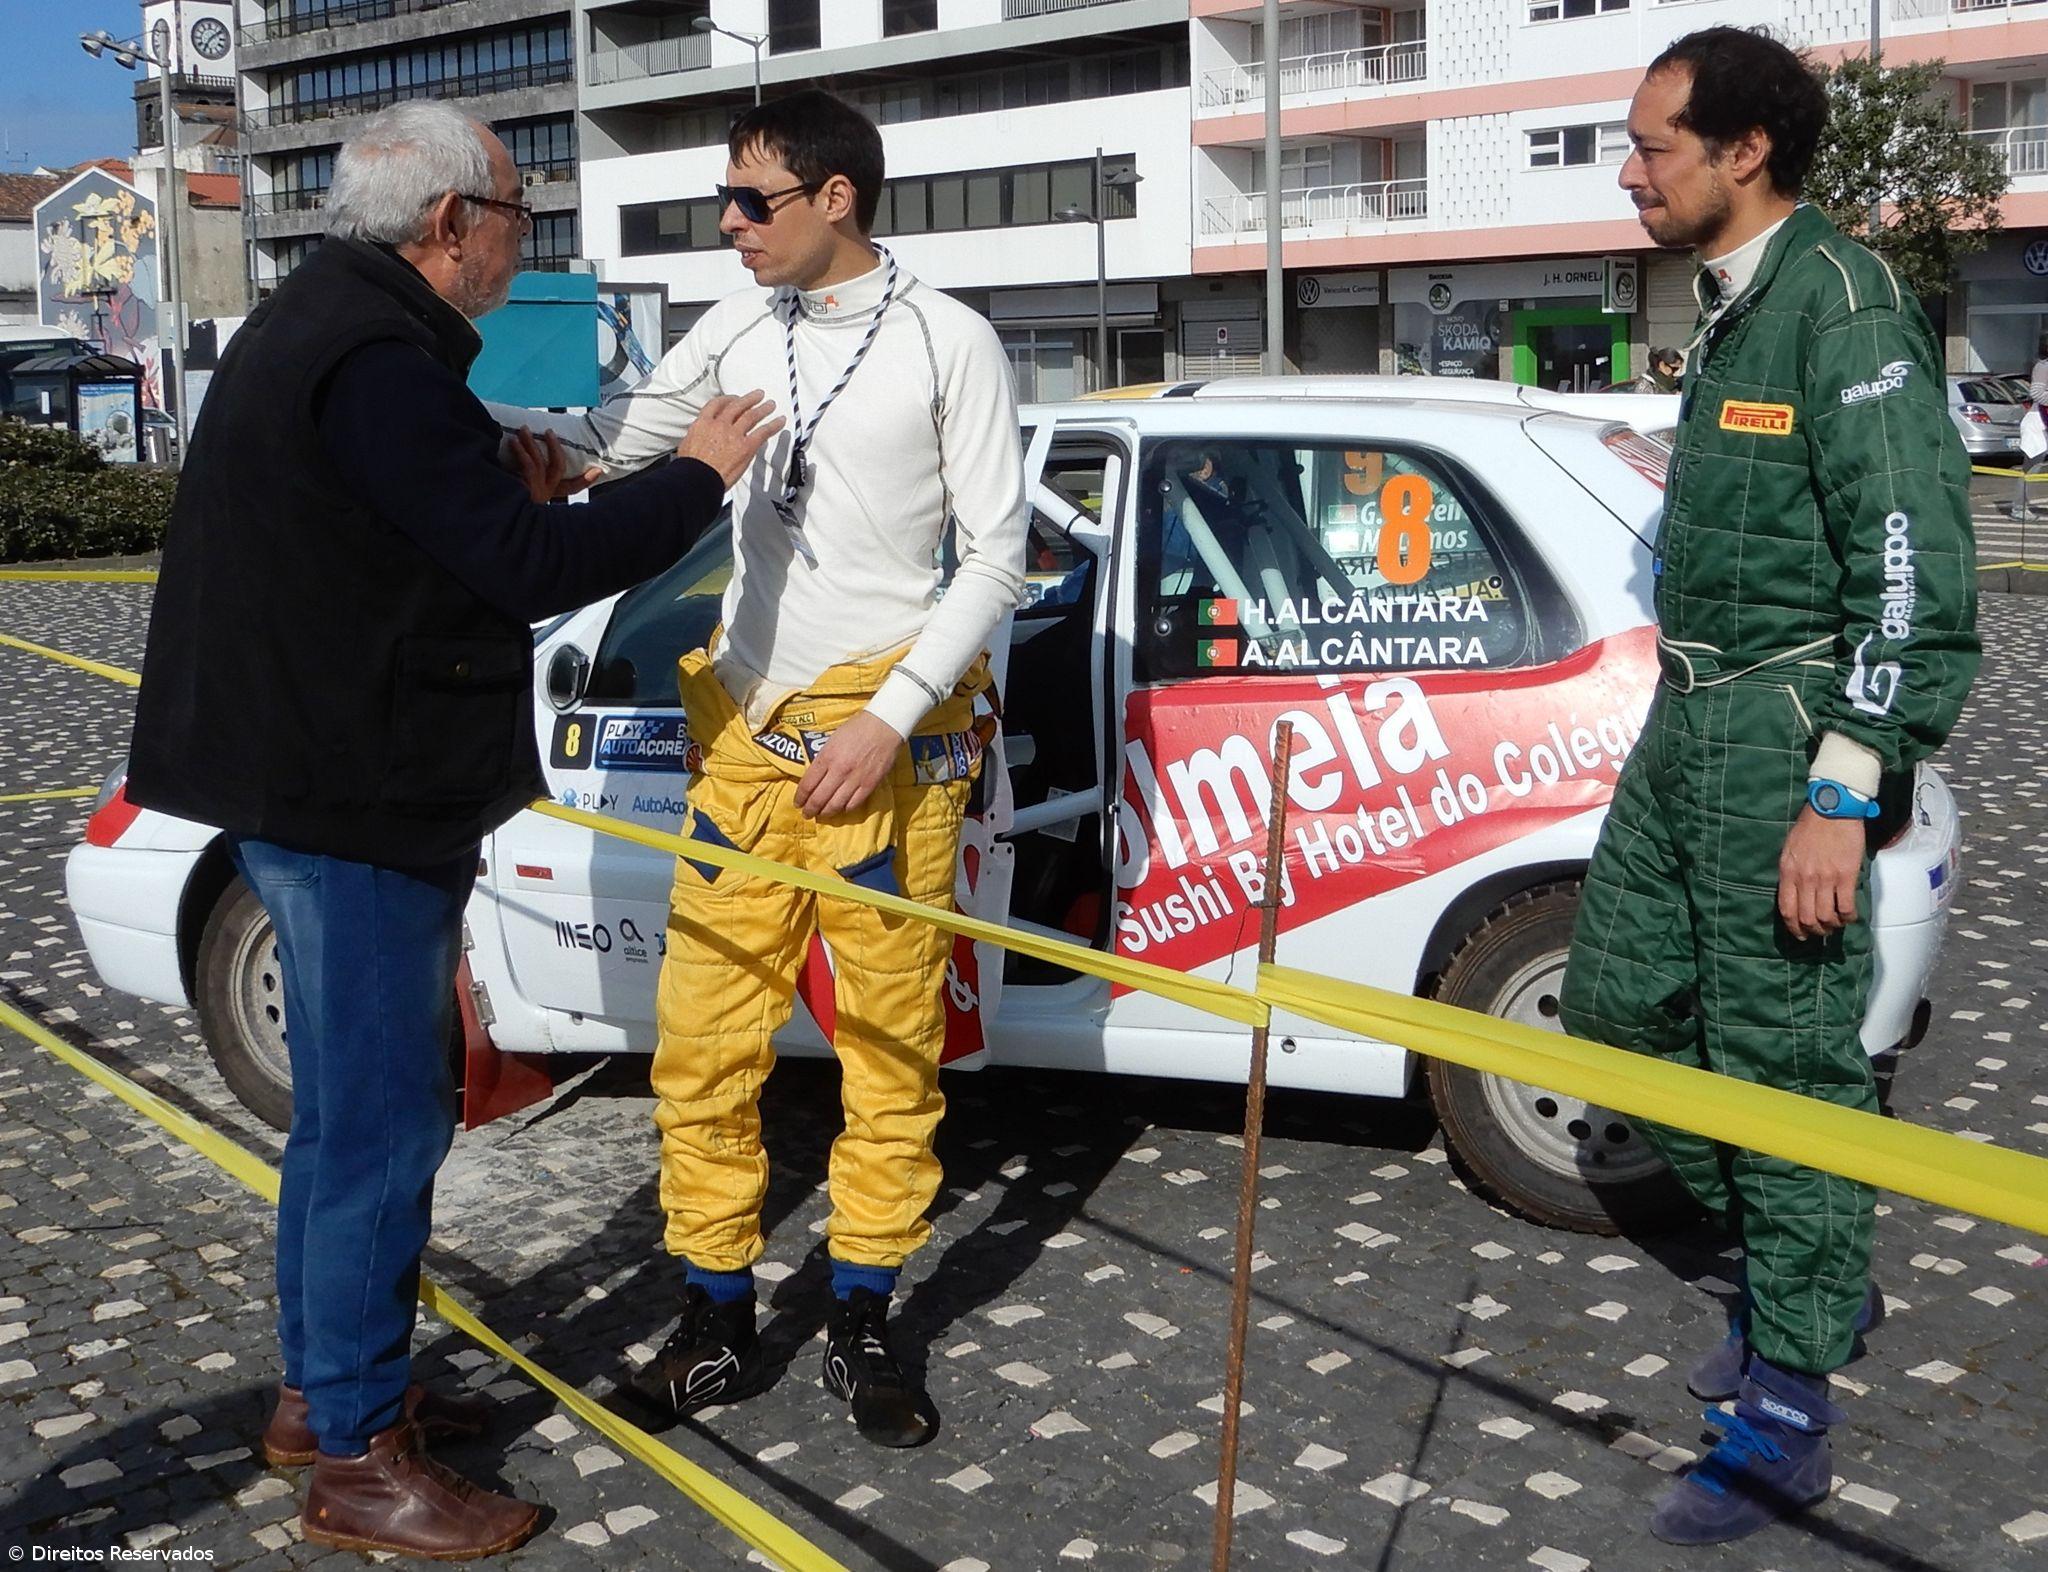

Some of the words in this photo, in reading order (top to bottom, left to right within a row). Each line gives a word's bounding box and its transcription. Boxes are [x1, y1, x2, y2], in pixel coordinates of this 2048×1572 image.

[1443, 336, 1492, 351] KAMIQ
[1841, 377, 1903, 404] galuppo
[1725, 407, 1789, 430] PIRELLI
[1377, 473, 1434, 585] 8
[1879, 511, 1915, 640] galuppo
[1243, 591, 1489, 625] H.ALCÂNTARA
[1240, 631, 1489, 667] A.ALCÂNTARA
[565, 723, 581, 757] 8
[600, 739, 687, 757] AUTOAÇORE
[632, 796, 687, 815] AutoAço
[1115, 865, 1235, 953] Sushi
[1295, 782, 1425, 880] Hotel
[1430, 768, 1488, 828] do
